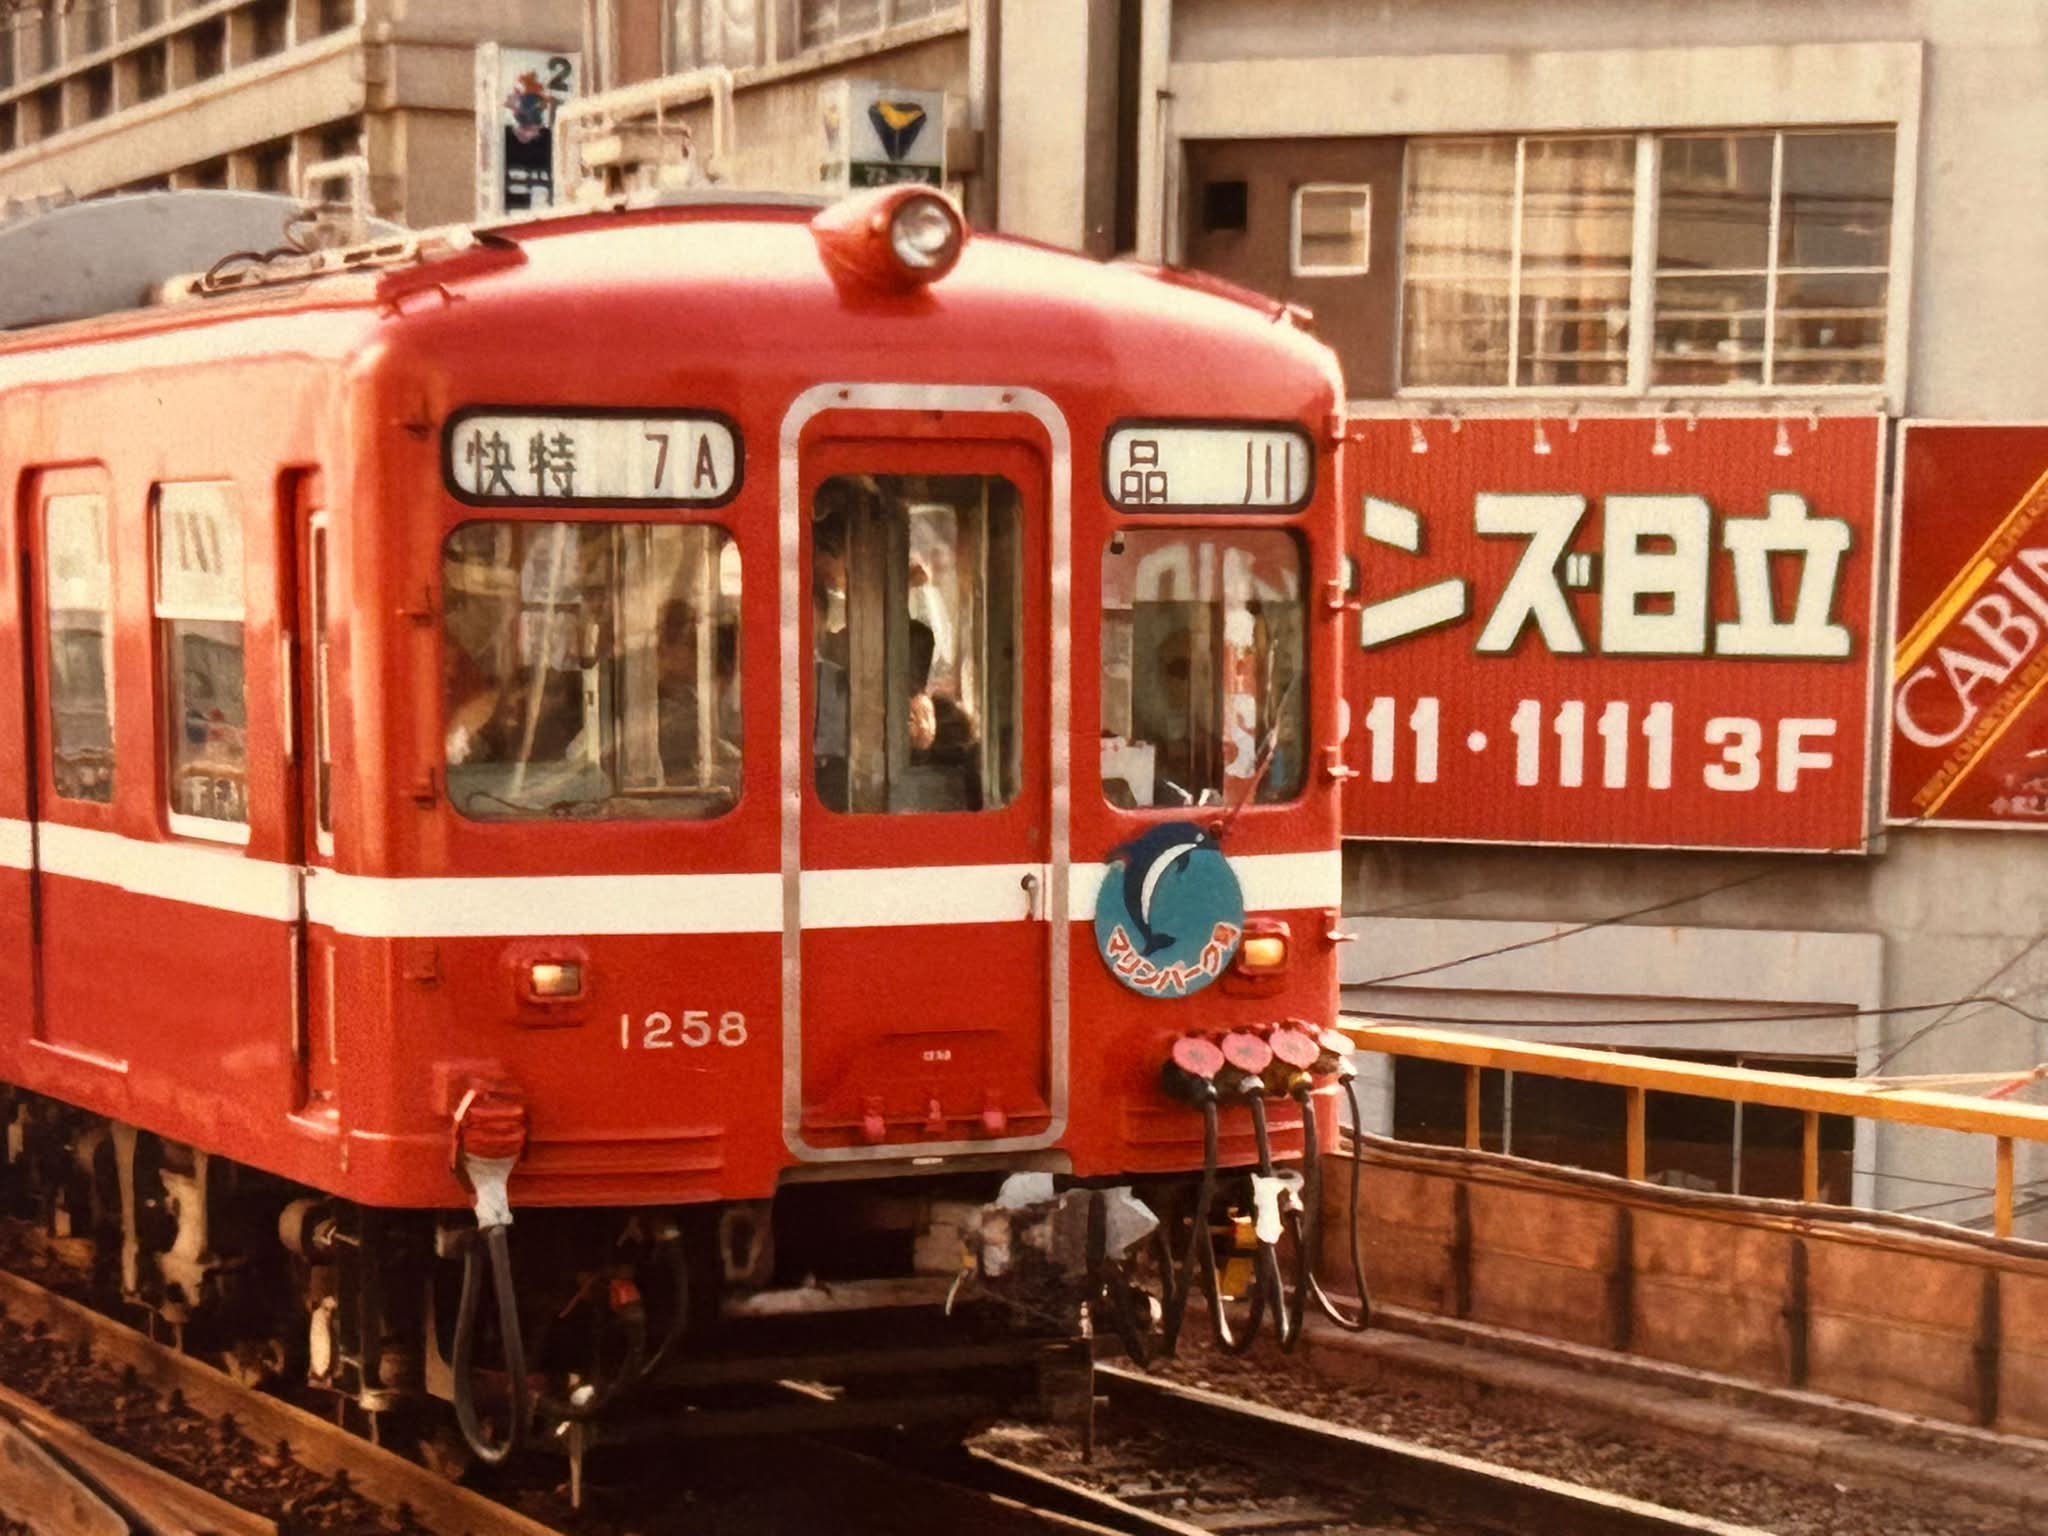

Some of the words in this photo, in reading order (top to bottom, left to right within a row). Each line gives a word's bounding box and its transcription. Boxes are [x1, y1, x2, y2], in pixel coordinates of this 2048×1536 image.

[547, 56, 572, 92] 2
[464, 428, 578, 496] 快特
[1120, 439, 1293, 504] 品川
[1342, 491, 1852, 657] ンズ日立
[1703, 716, 1838, 792] 3F
[619, 1010, 748, 1050] 1258
